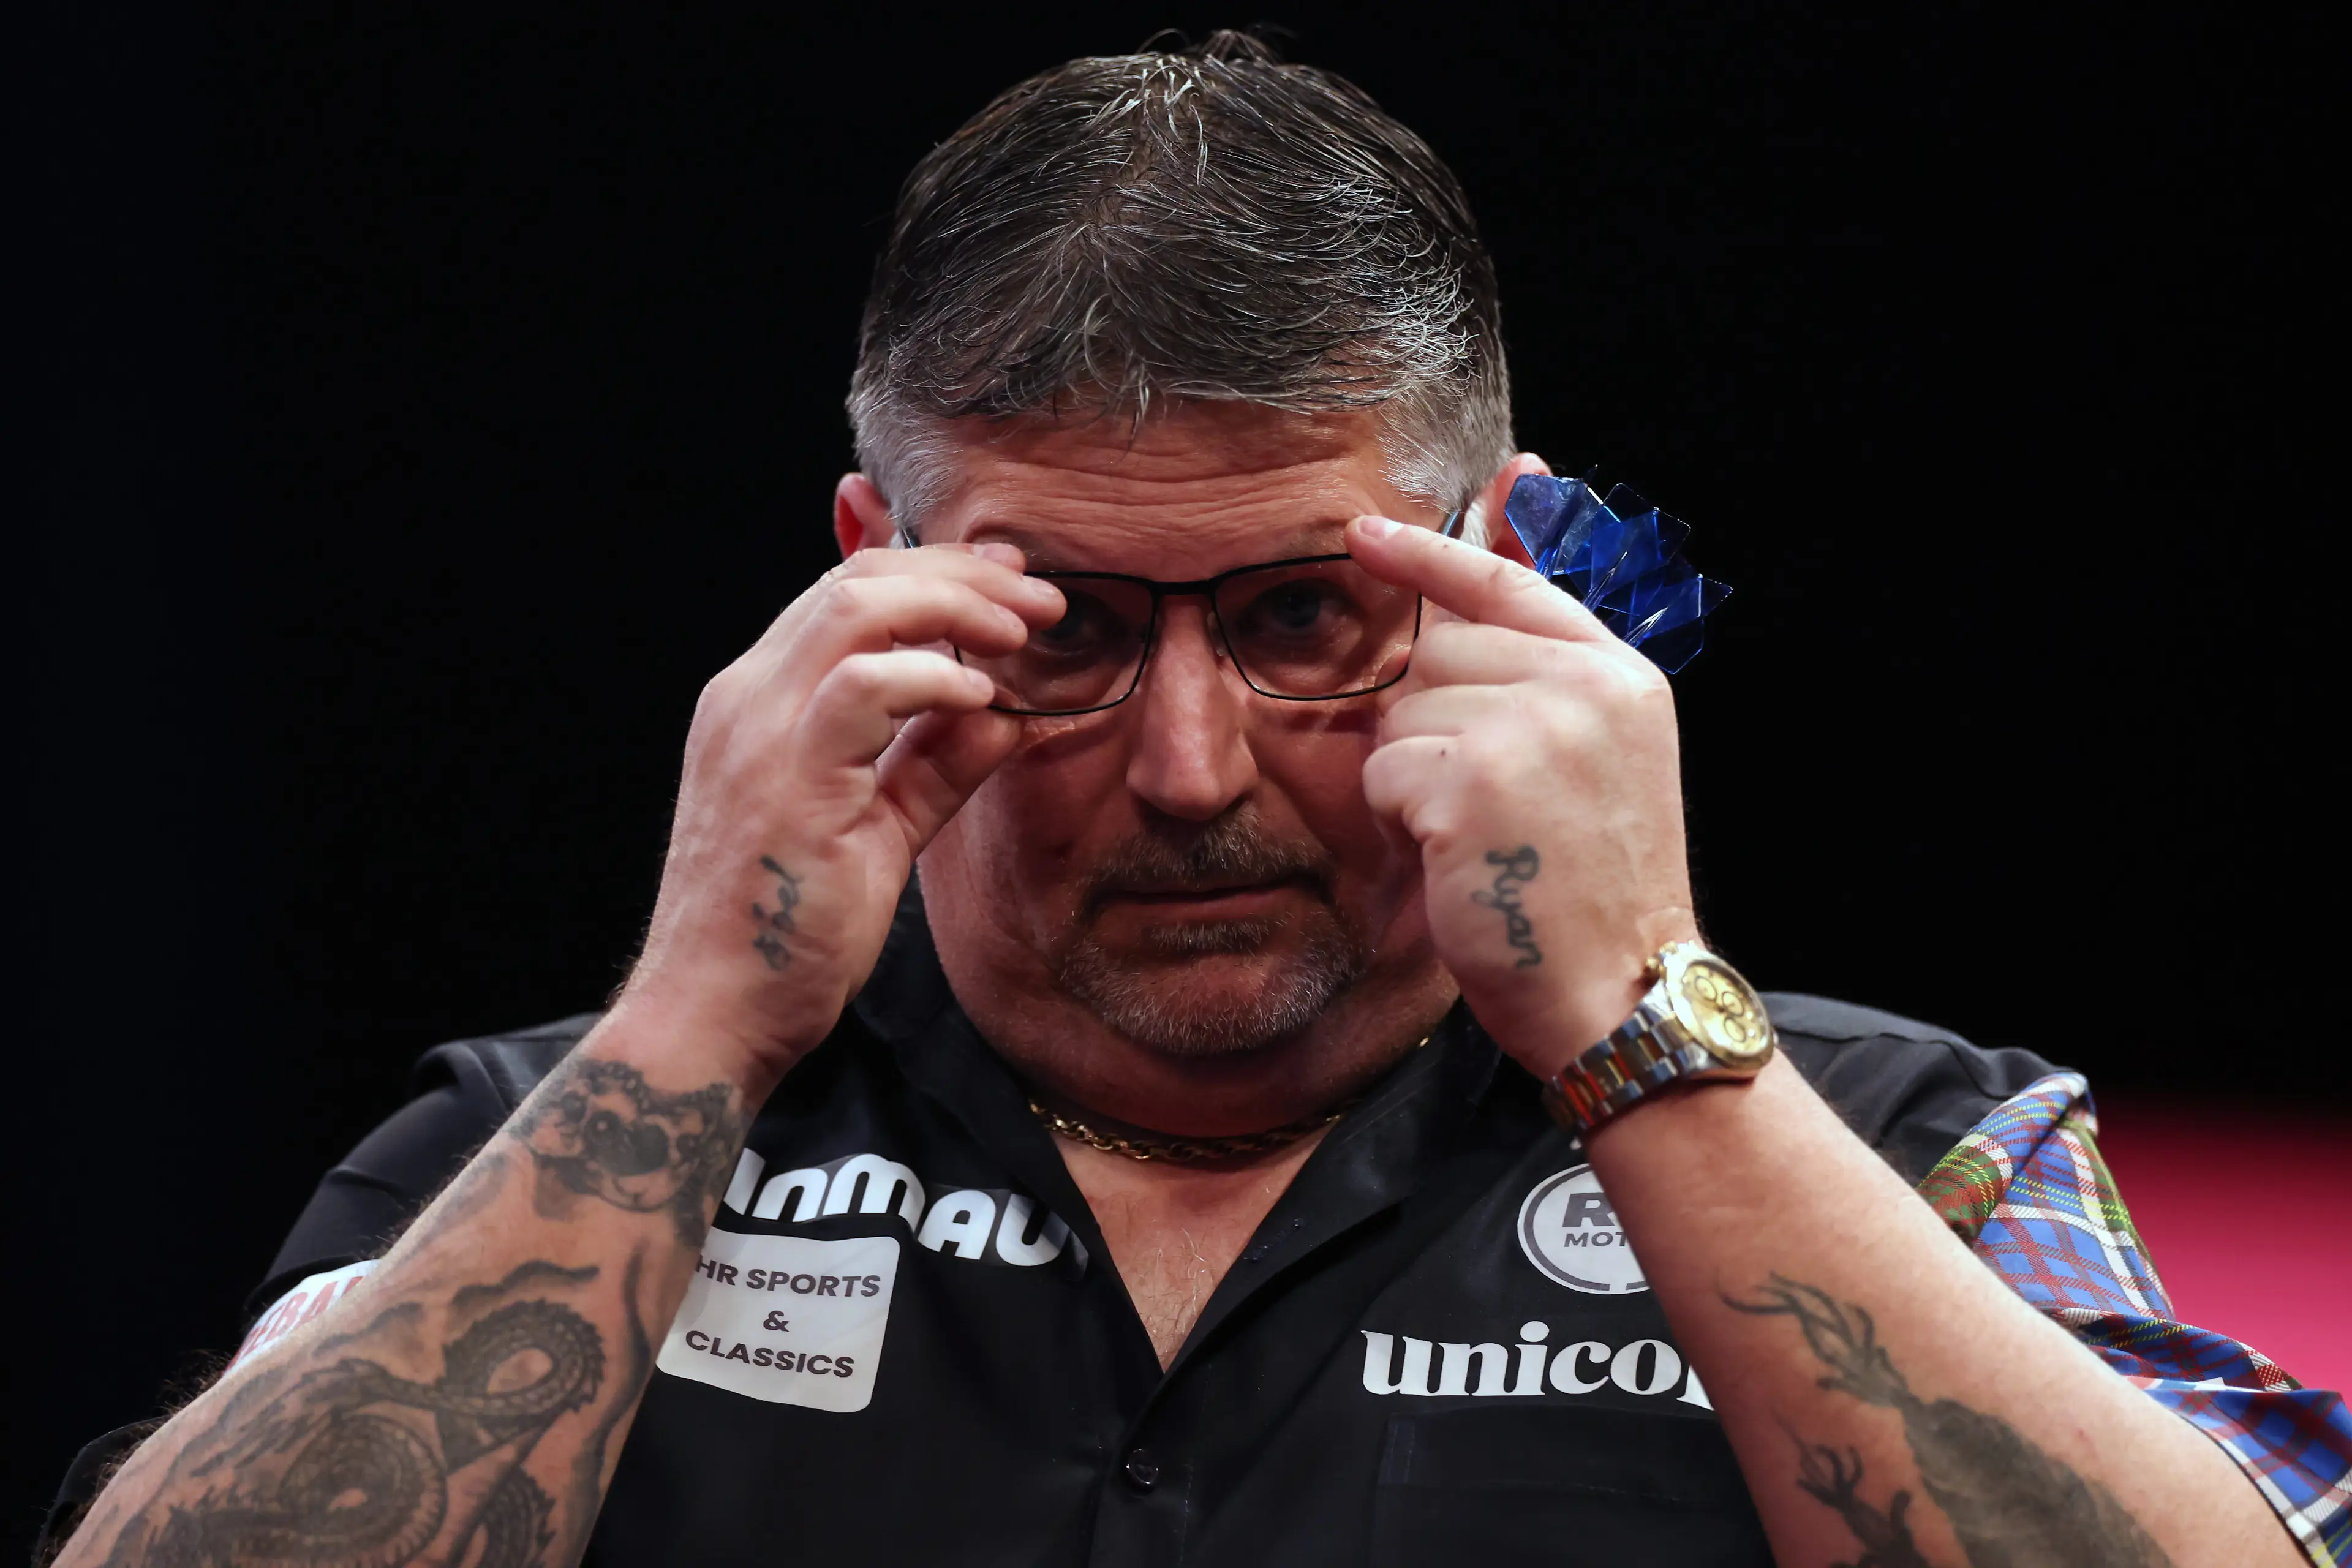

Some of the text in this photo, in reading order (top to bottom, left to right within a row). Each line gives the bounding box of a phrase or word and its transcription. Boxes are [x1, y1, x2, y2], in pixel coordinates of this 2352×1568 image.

[1471, 846, 1542, 969] Ryan
[746, 1268, 881, 1297] SPORTS
[763, 1310, 790, 1332] &
[685, 1330, 854, 1378] CLASSICS
